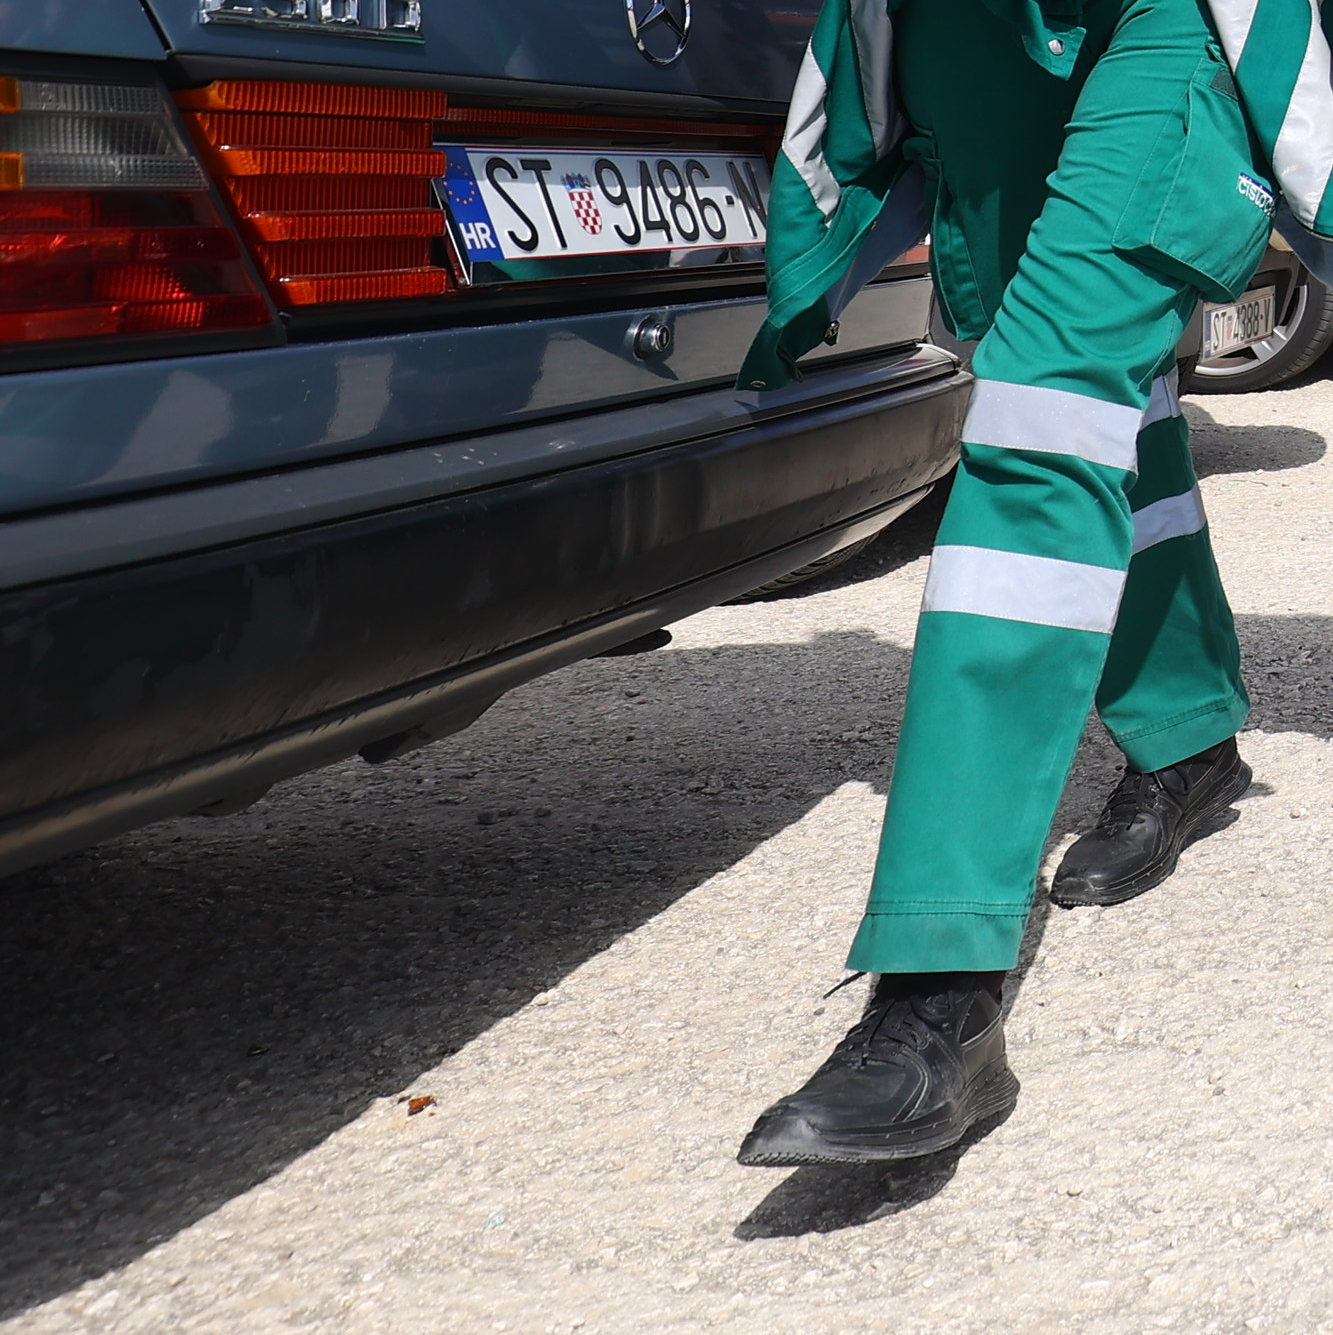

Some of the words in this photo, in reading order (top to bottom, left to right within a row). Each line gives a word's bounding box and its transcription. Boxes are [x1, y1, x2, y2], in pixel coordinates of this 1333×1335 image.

[484, 156, 568, 252] ST
[459, 221, 497, 251] HR
[1213, 311, 1227, 352] ST
